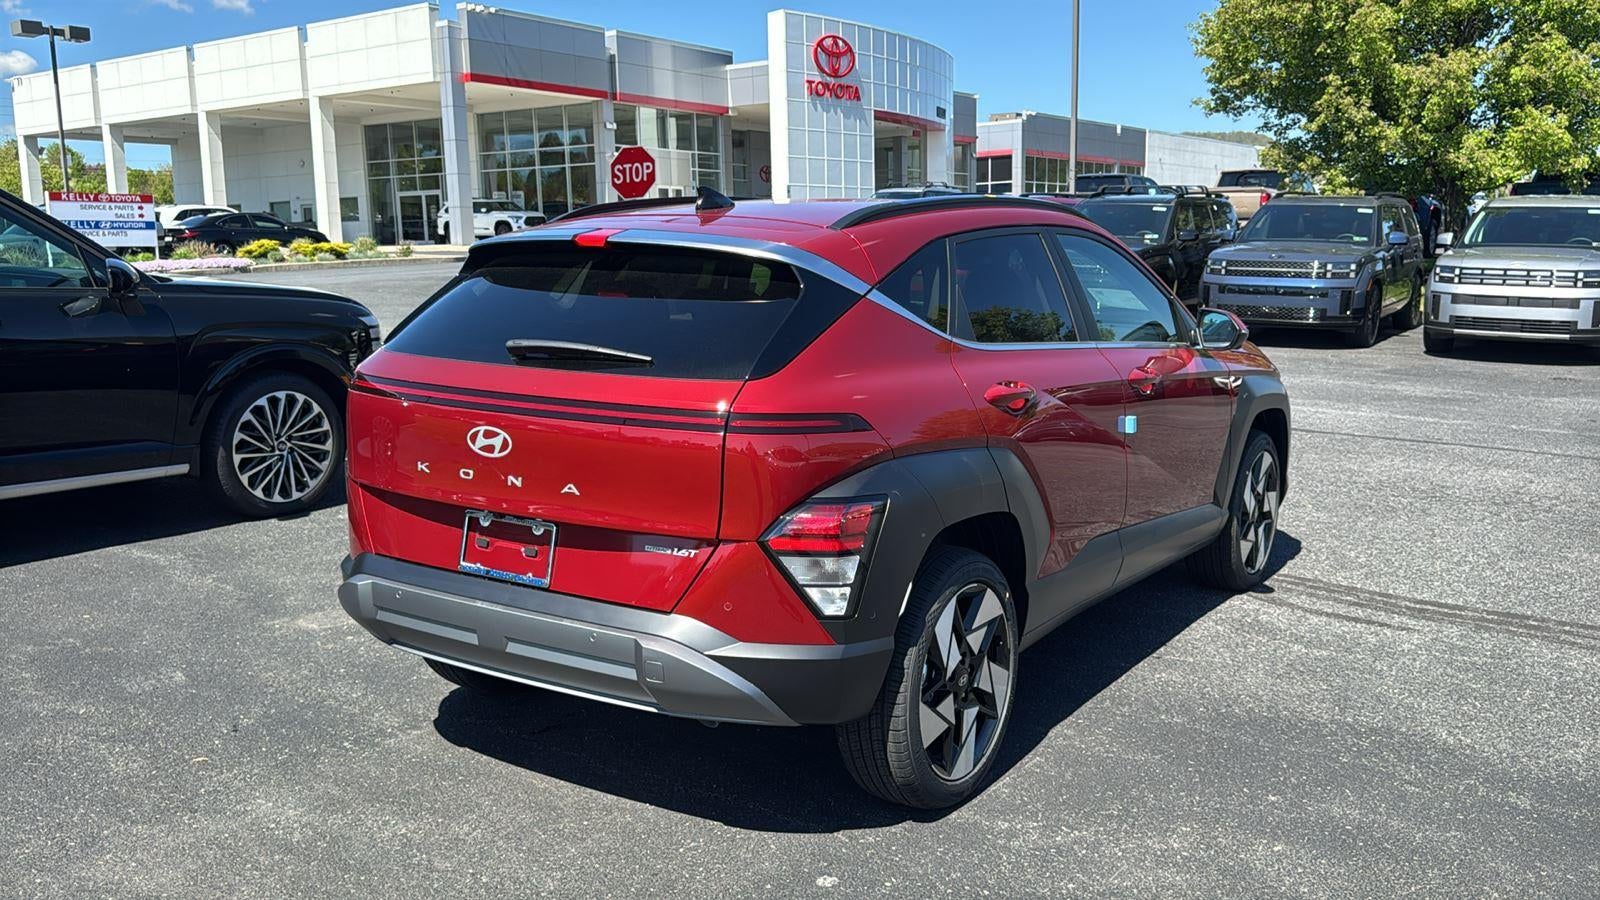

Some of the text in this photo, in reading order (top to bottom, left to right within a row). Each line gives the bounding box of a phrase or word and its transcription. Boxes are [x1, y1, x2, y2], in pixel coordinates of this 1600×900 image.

[806, 79, 861, 102] TOYOTA
[613, 162, 653, 184] STOP
[61, 193, 94, 201] KELLY
[417, 461, 580, 496] KONA
